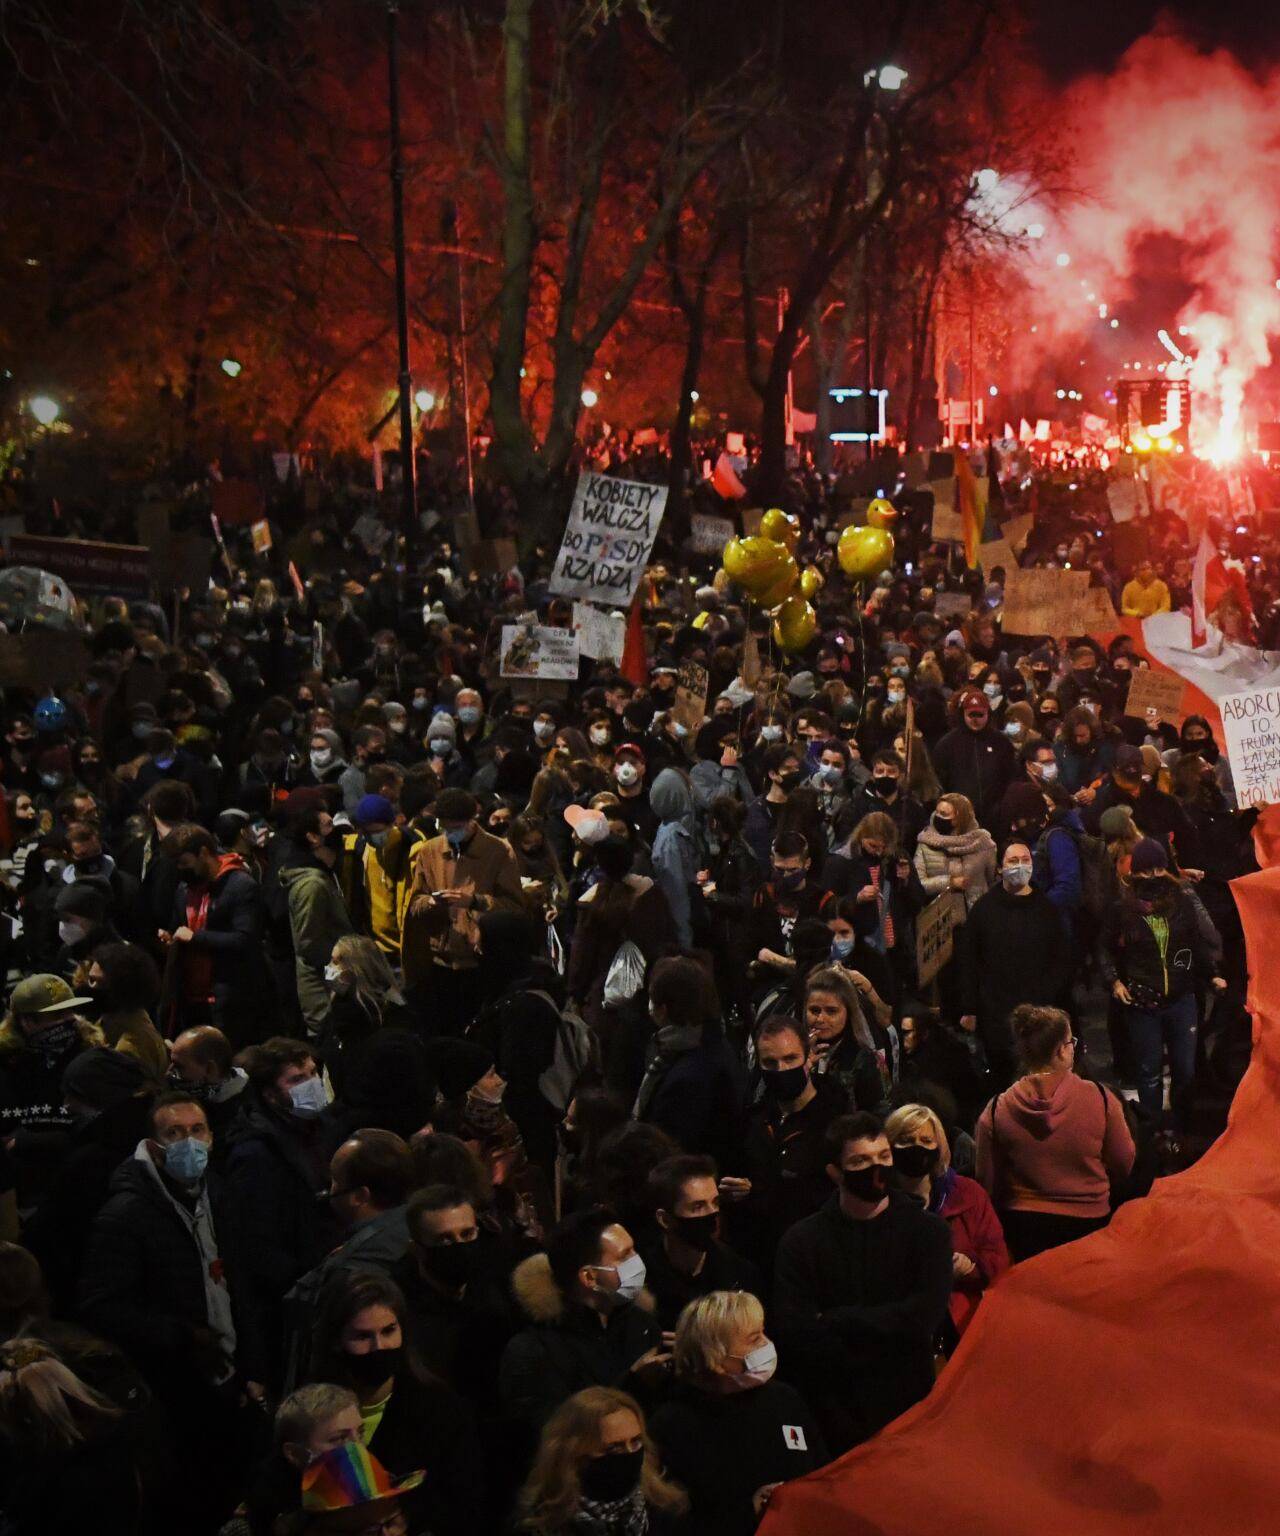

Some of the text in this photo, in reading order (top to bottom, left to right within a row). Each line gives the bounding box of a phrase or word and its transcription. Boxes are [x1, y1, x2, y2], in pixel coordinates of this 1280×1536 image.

[587, 476, 659, 510] KOBIETY
[565, 531, 583, 550] BO
[1251, 716, 1271, 733] TO
